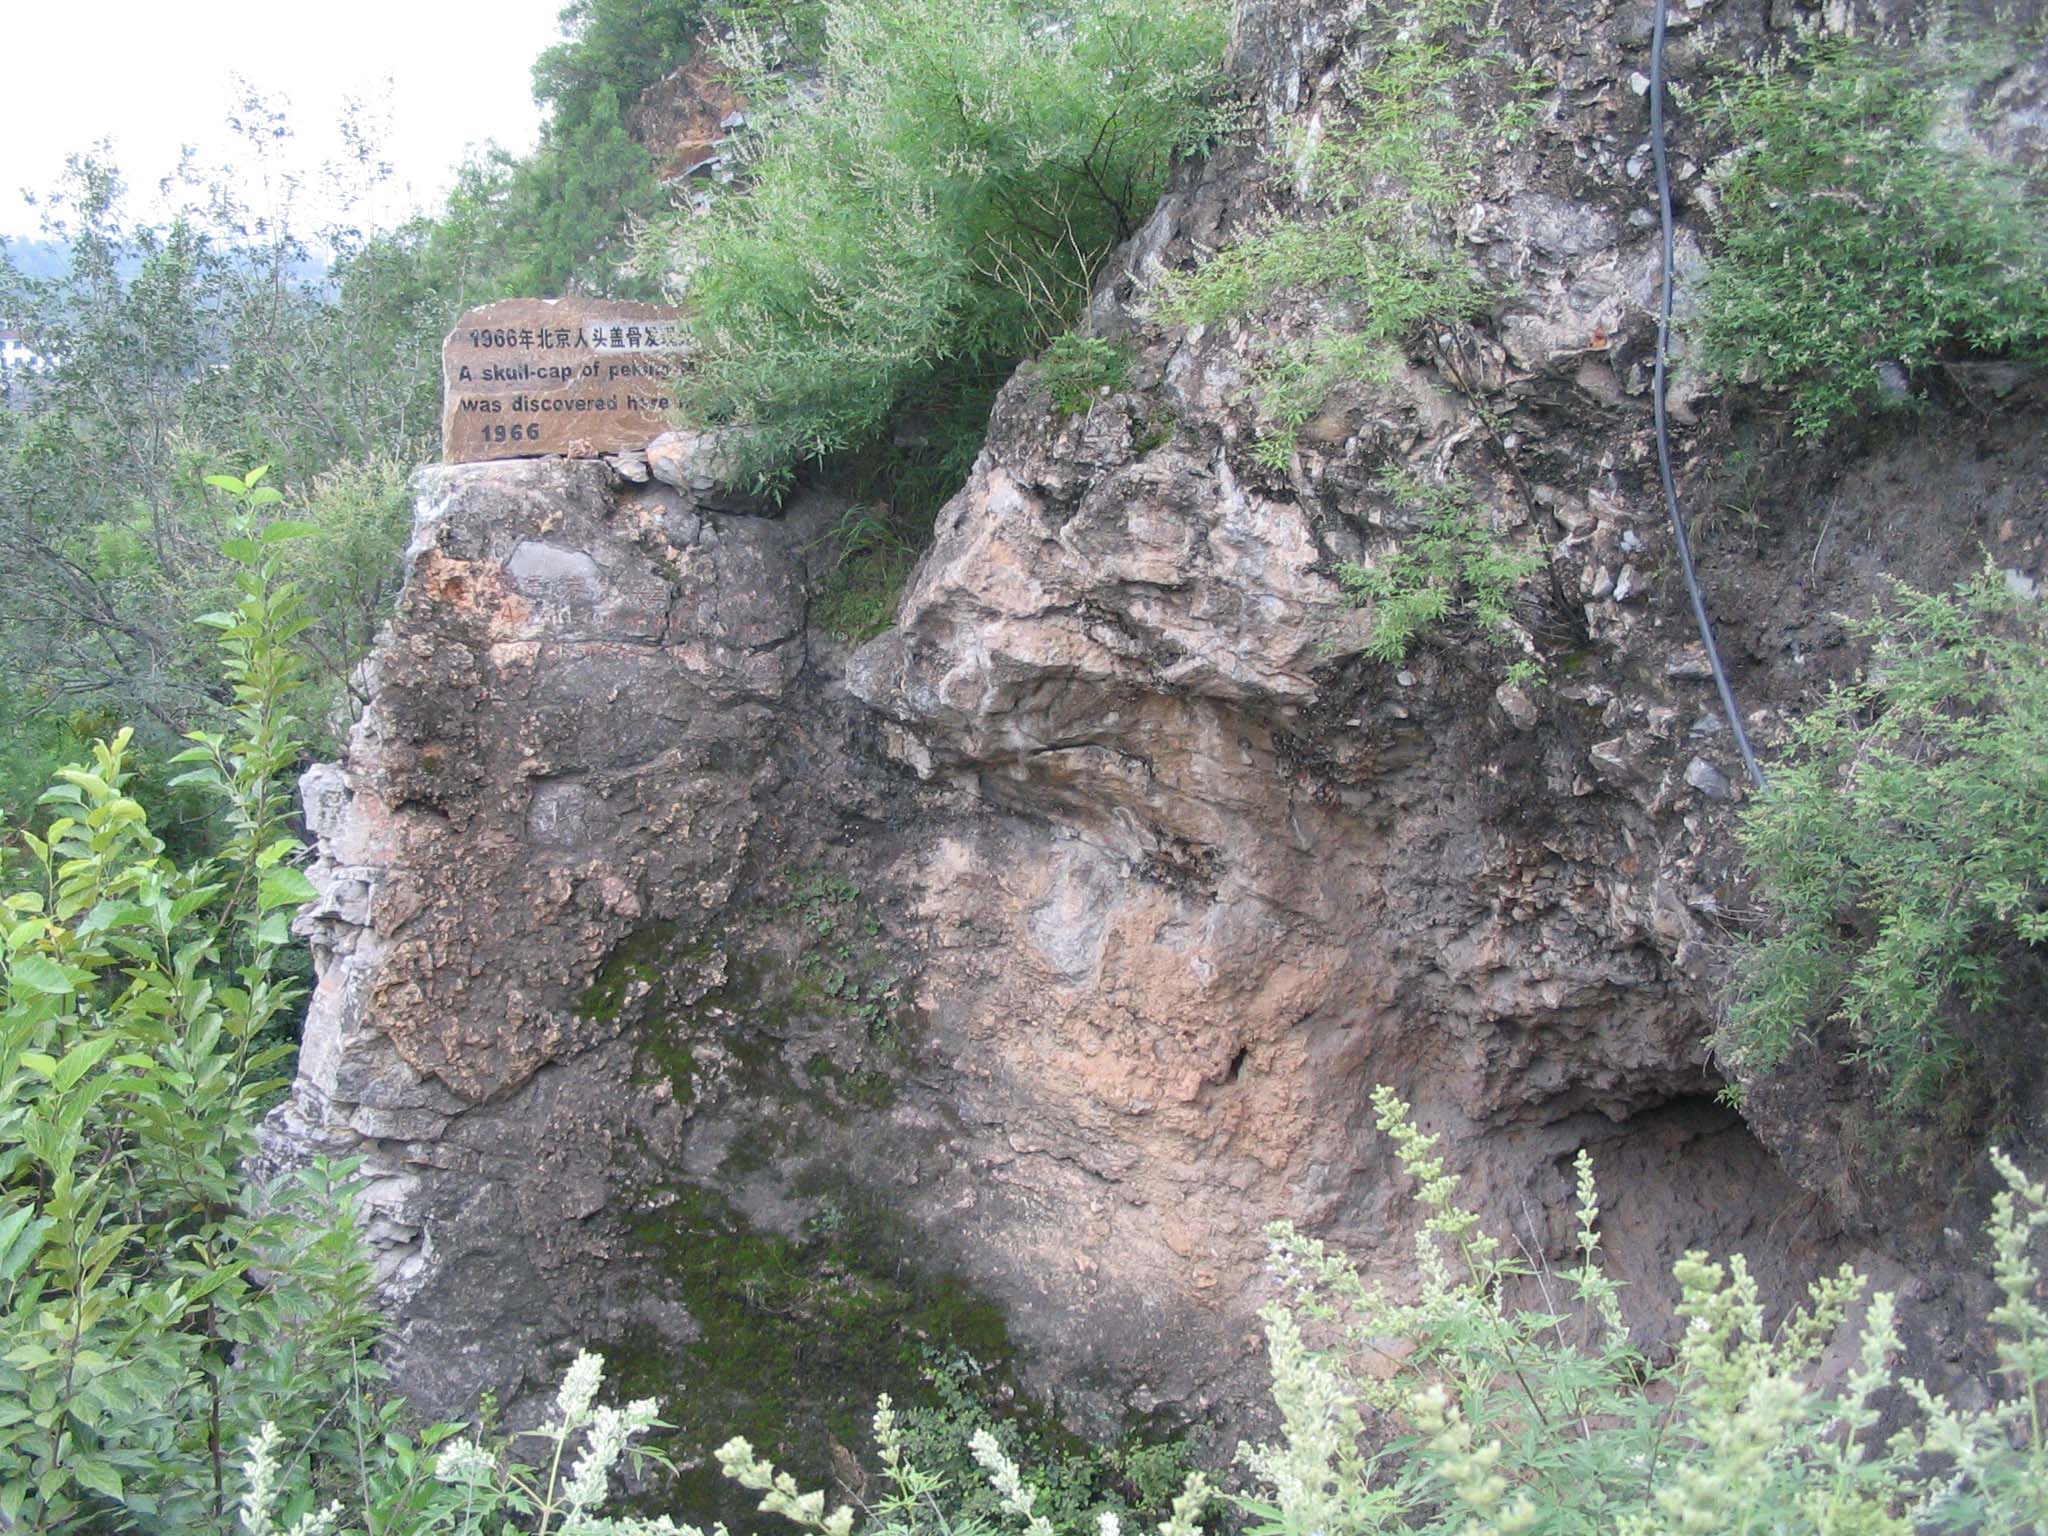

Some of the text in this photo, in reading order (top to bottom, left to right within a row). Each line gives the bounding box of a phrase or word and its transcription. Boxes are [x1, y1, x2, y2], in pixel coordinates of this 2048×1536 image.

[459, 365, 472, 382] A
[482, 364, 572, 382] skull-cap
[582, 361, 600, 377] of
[462, 398, 502, 413] was
[512, 395, 618, 412] discovered
[481, 422, 540, 443] 1966
